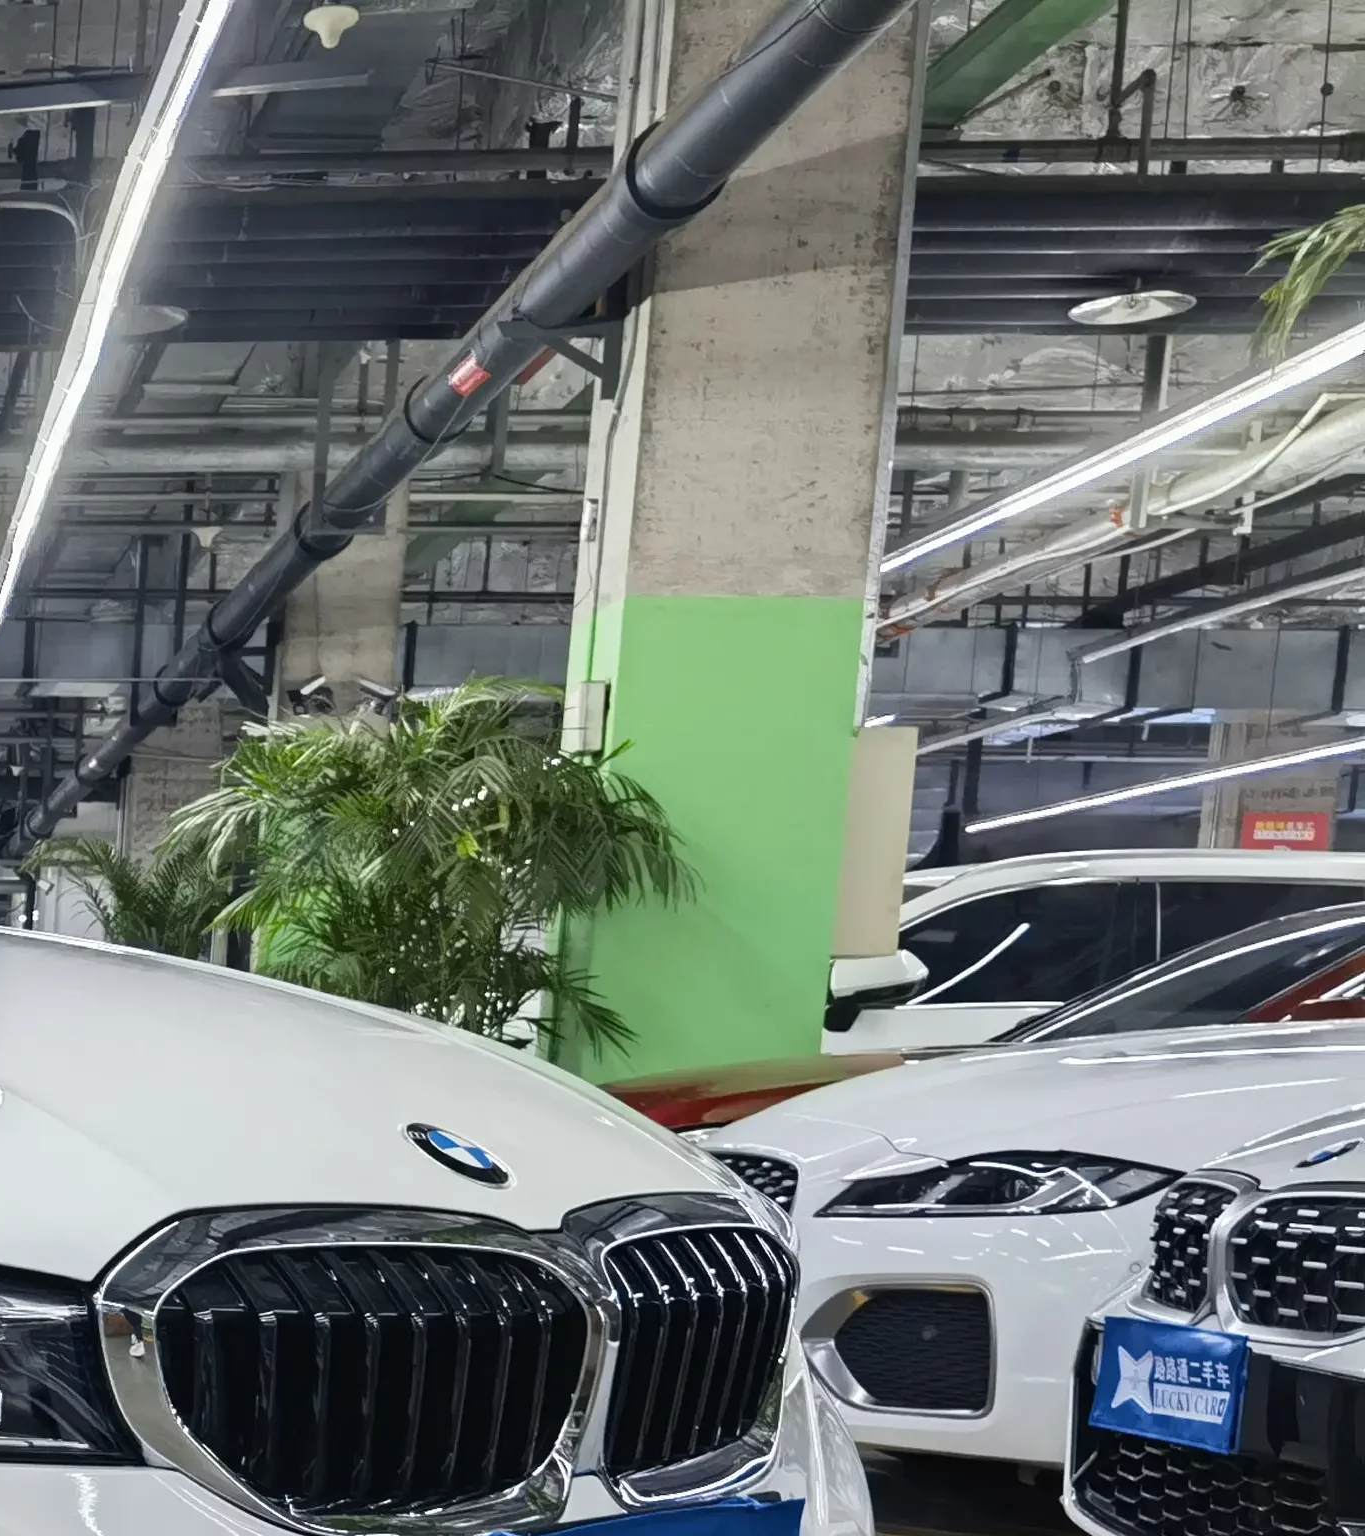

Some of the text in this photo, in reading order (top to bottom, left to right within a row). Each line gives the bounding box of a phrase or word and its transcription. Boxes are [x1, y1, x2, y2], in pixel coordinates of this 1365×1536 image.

[1154, 1356, 1231, 1389] 路路通二手车
[1154, 1389, 1192, 1413] LUCKY
